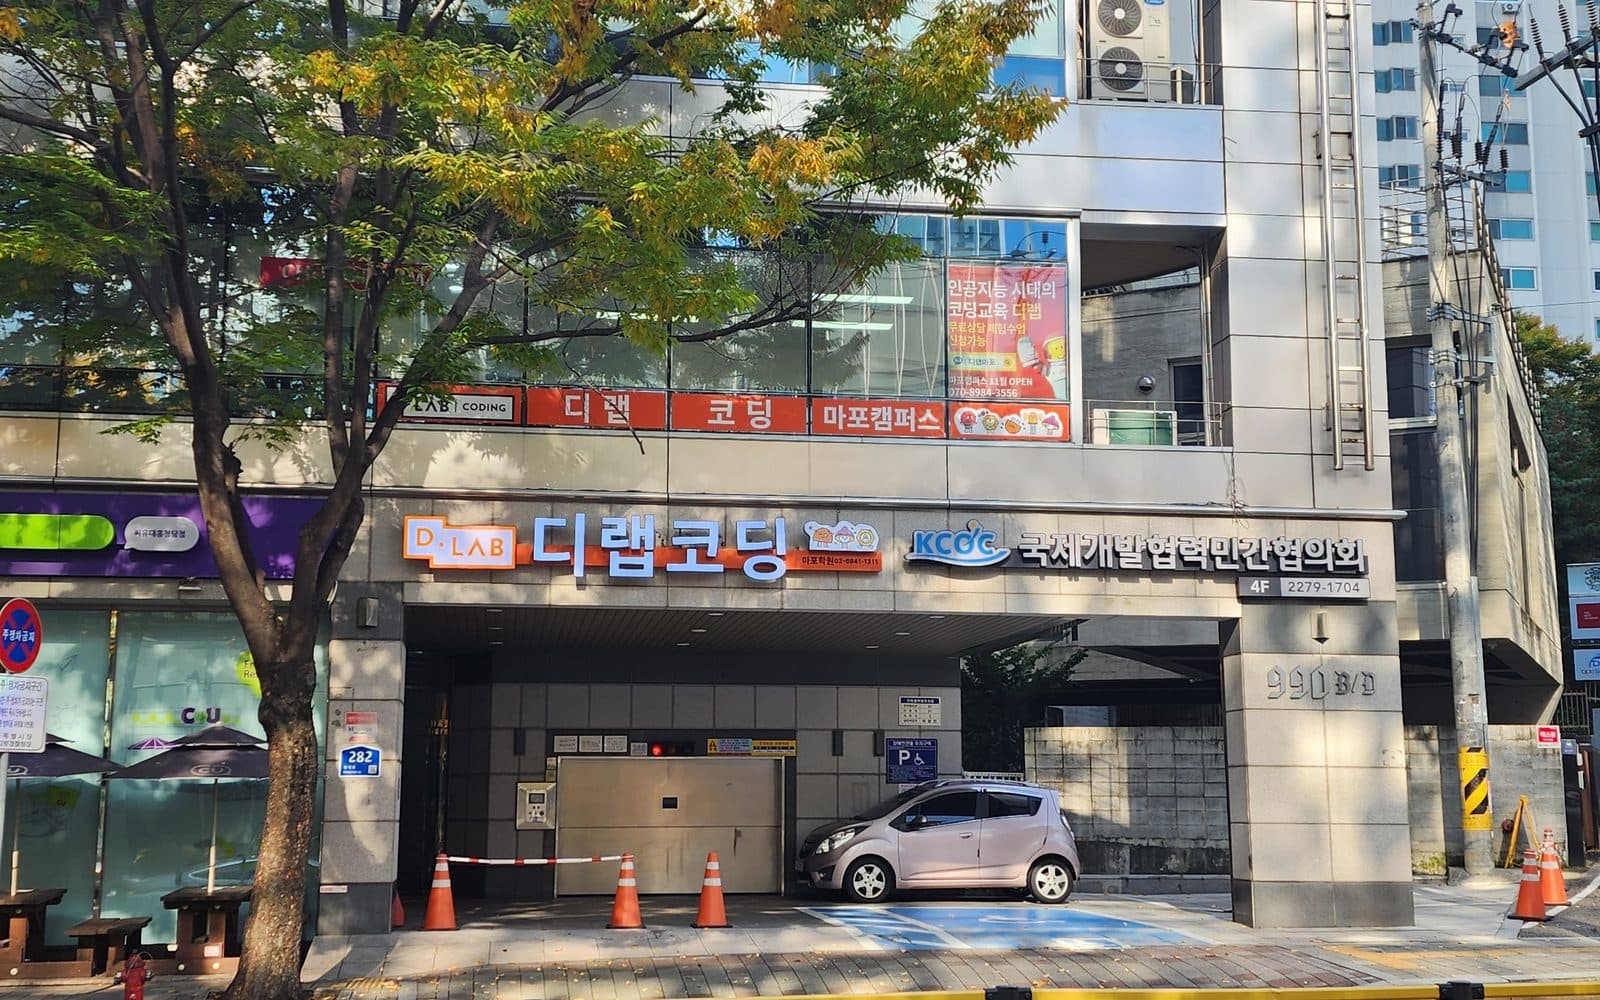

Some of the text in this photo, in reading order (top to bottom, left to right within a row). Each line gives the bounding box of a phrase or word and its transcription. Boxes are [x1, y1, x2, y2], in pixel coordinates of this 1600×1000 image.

[949, 281, 1056, 300] 인공지능 시대의
[949, 302, 1042, 320] 코딩교육 디랩
[1009, 377, 1033, 387] OPEN
[949, 387, 1018, 398] 070-8984-3556
[462, 402, 507, 413] CODING
[823, 404, 942, 432] 마포캠퍼스
[533, 512, 787, 583] 디랩코딩
[916, 528, 995, 556] KCOC
[1018, 532, 1366, 573] 국제개발협력민간협의회
[1250, 579, 1361, 594] 4F 2279-1704
[1266, 664, 1330, 700] 990
[348, 750, 373, 763] 282
[899, 750, 911, 766] P
